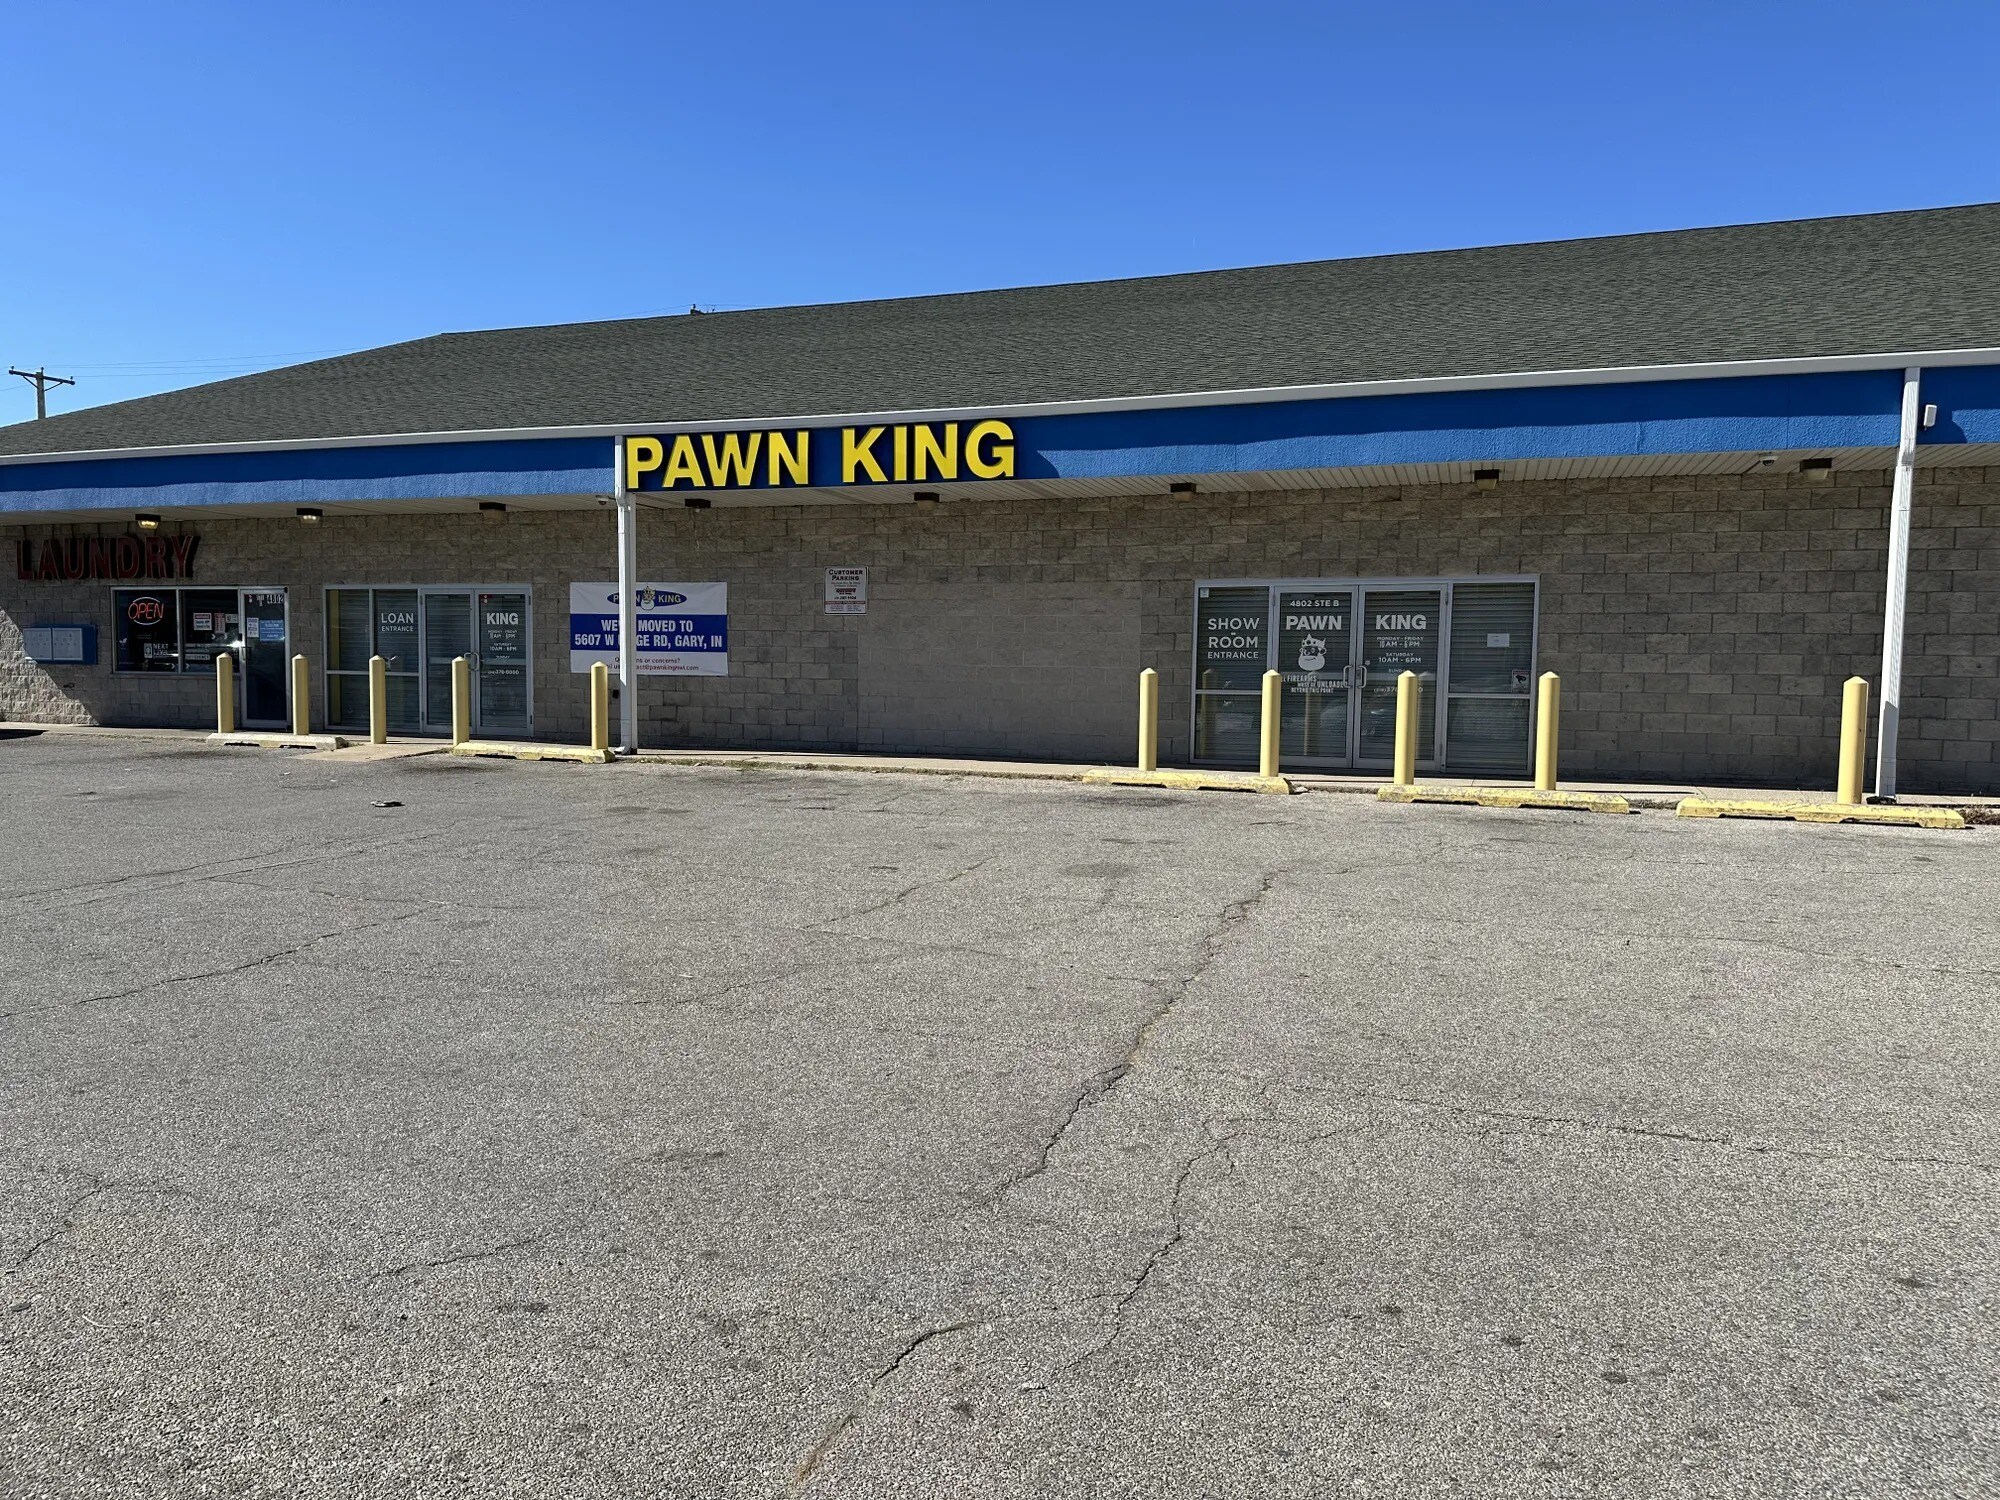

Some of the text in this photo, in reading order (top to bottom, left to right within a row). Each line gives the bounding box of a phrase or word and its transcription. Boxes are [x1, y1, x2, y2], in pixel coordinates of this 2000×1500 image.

[626, 420, 1015, 489] PAWN KING
[16, 535, 194, 580] LAUNDRY
[613, 594, 682, 603] PN KING
[128, 602, 164, 620] OPEN
[381, 612, 414, 623] LOAN
[486, 612, 519, 625] KING
[1207, 617, 1260, 630] SHOW
[1286, 615, 1342, 630] PAWN
[1375, 614, 1427, 630] KING
[638, 620, 676, 632] MOVED
[680, 620, 693, 632] TO
[575, 634, 601, 646] 5607
[605, 634, 614, 646] W
[653, 635, 672, 649] RD,
[675, 635, 707, 650] GARY,
[711, 635, 722, 647] IN
[1208, 636, 1258, 649] ROOM
[1207, 651, 1259, 659] ENTRANCE
